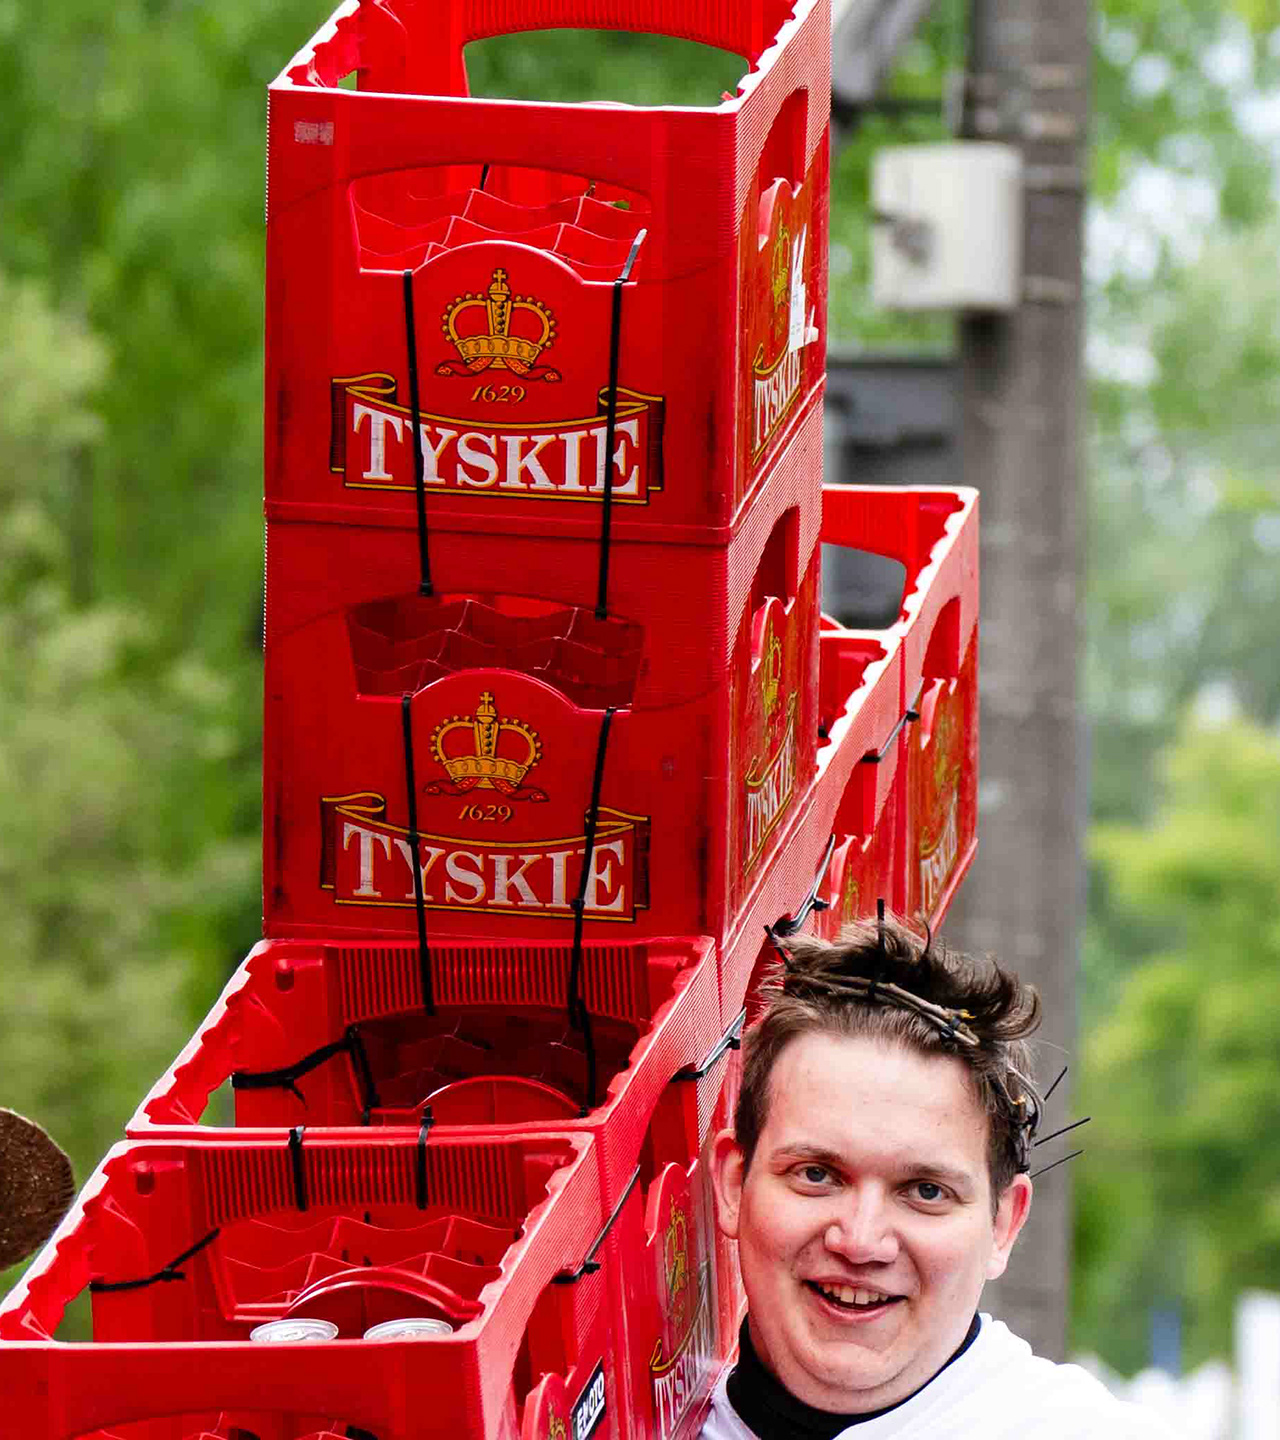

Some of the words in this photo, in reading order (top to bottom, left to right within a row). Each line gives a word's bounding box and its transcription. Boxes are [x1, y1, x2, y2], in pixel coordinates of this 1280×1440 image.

[470, 383, 526, 405] 1629
[353, 401, 641, 496] TYSKIE
[458, 803, 513, 825] 1629
[343, 821, 627, 912] TYSKIE
